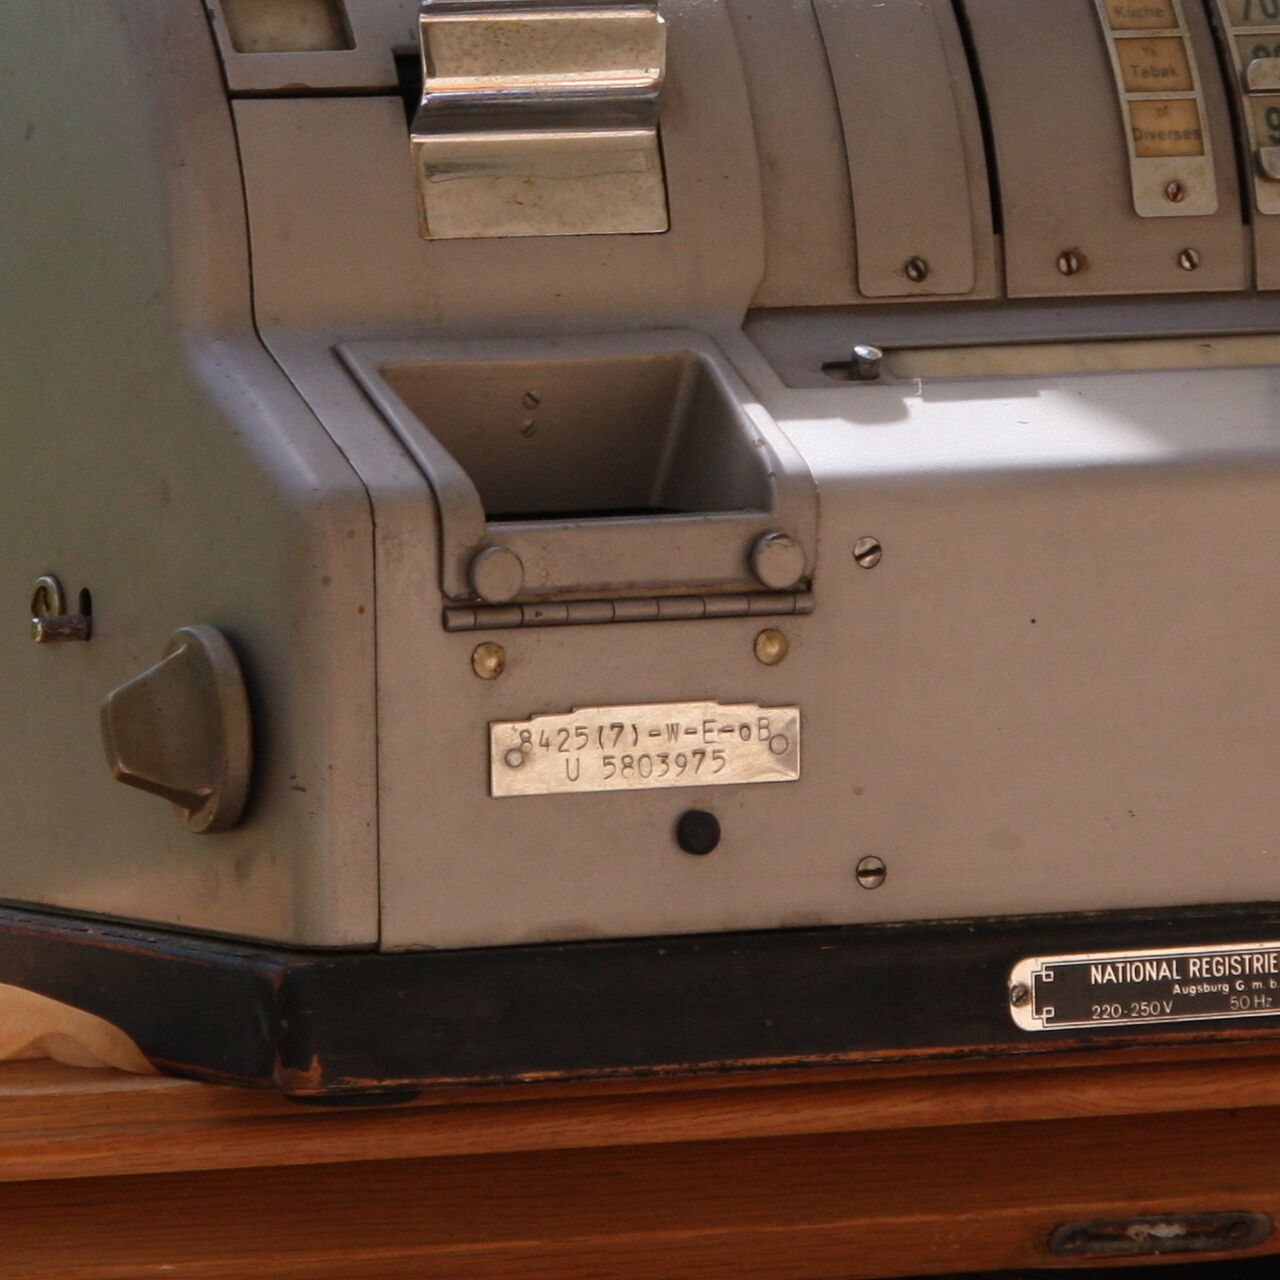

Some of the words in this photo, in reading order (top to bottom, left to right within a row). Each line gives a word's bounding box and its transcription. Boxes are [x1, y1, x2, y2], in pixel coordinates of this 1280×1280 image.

[1131, 125, 1202, 142] Diverses
[565, 757, 581, 782] U
[602, 749, 727, 781] 5803975
[1090, 960, 1182, 985] NATIONAL
[1172, 982, 1230, 997] Augsburg
